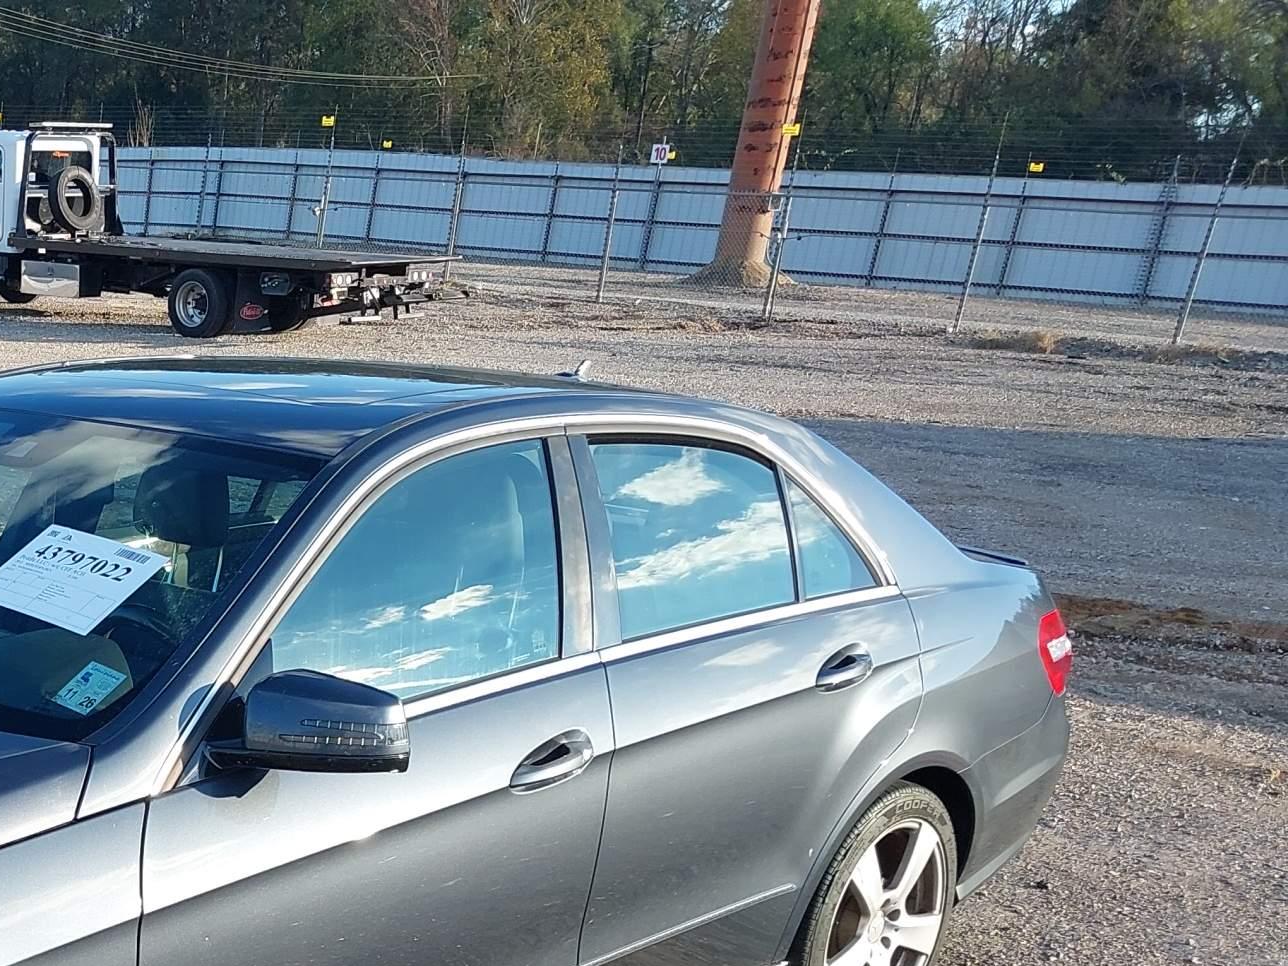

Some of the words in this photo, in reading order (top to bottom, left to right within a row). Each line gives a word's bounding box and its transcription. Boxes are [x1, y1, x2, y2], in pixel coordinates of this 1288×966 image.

[654, 147, 667, 161] 10
[34, 544, 132, 582] 43797022
[63, 687, 79, 700] 11
[78, 696, 97, 709] 26
